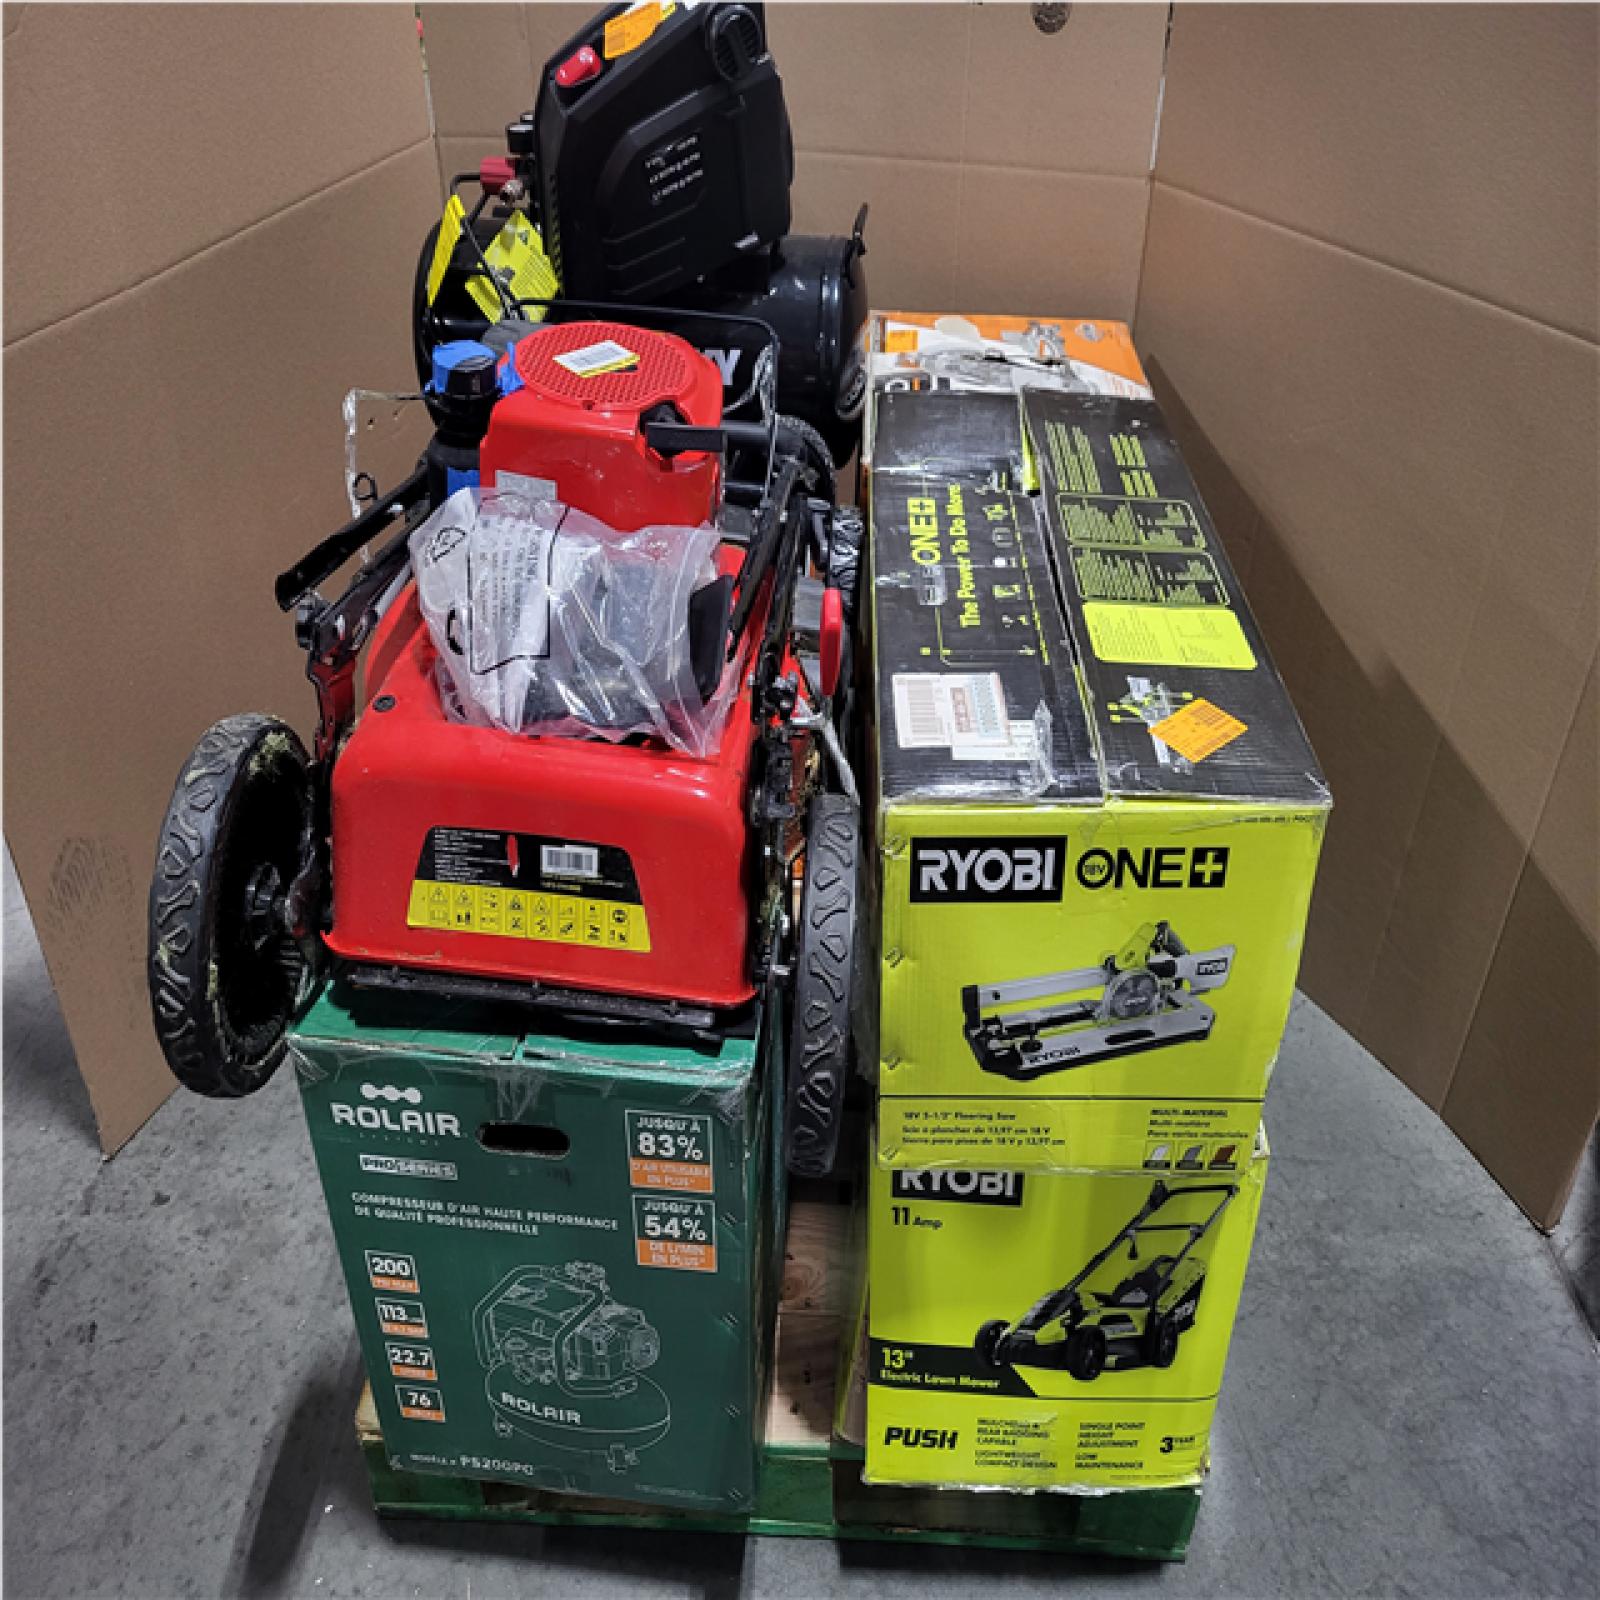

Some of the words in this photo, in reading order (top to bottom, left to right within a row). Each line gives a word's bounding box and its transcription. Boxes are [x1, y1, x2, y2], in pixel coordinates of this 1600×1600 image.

[946, 483, 966, 516] More
[949, 517, 968, 536] Do
[951, 539, 970, 555] To
[957, 556, 976, 599] Power
[960, 602, 981, 628] The
[917, 848, 1056, 891] RYOBI
[330, 1102, 461, 1138] ROLAIR
[637, 1132, 703, 1161] 83%
[901, 1169, 1015, 1197] RYOBI
[644, 1214, 708, 1242] 54%
[892, 1206, 910, 1226] 11
[912, 1215, 944, 1230] Amp
[372, 1256, 412, 1277] 200
[388, 1347, 431, 1367] 22.7
[880, 1368, 922, 1384] Electric
[924, 1372, 956, 1384] Lawn
[959, 1374, 1001, 1389] Mower
[407, 1392, 433, 1408] 76
[501, 1391, 583, 1426] ROLAIR
[884, 1426, 959, 1450] PUSH
[1160, 1436, 1174, 1454] 3
